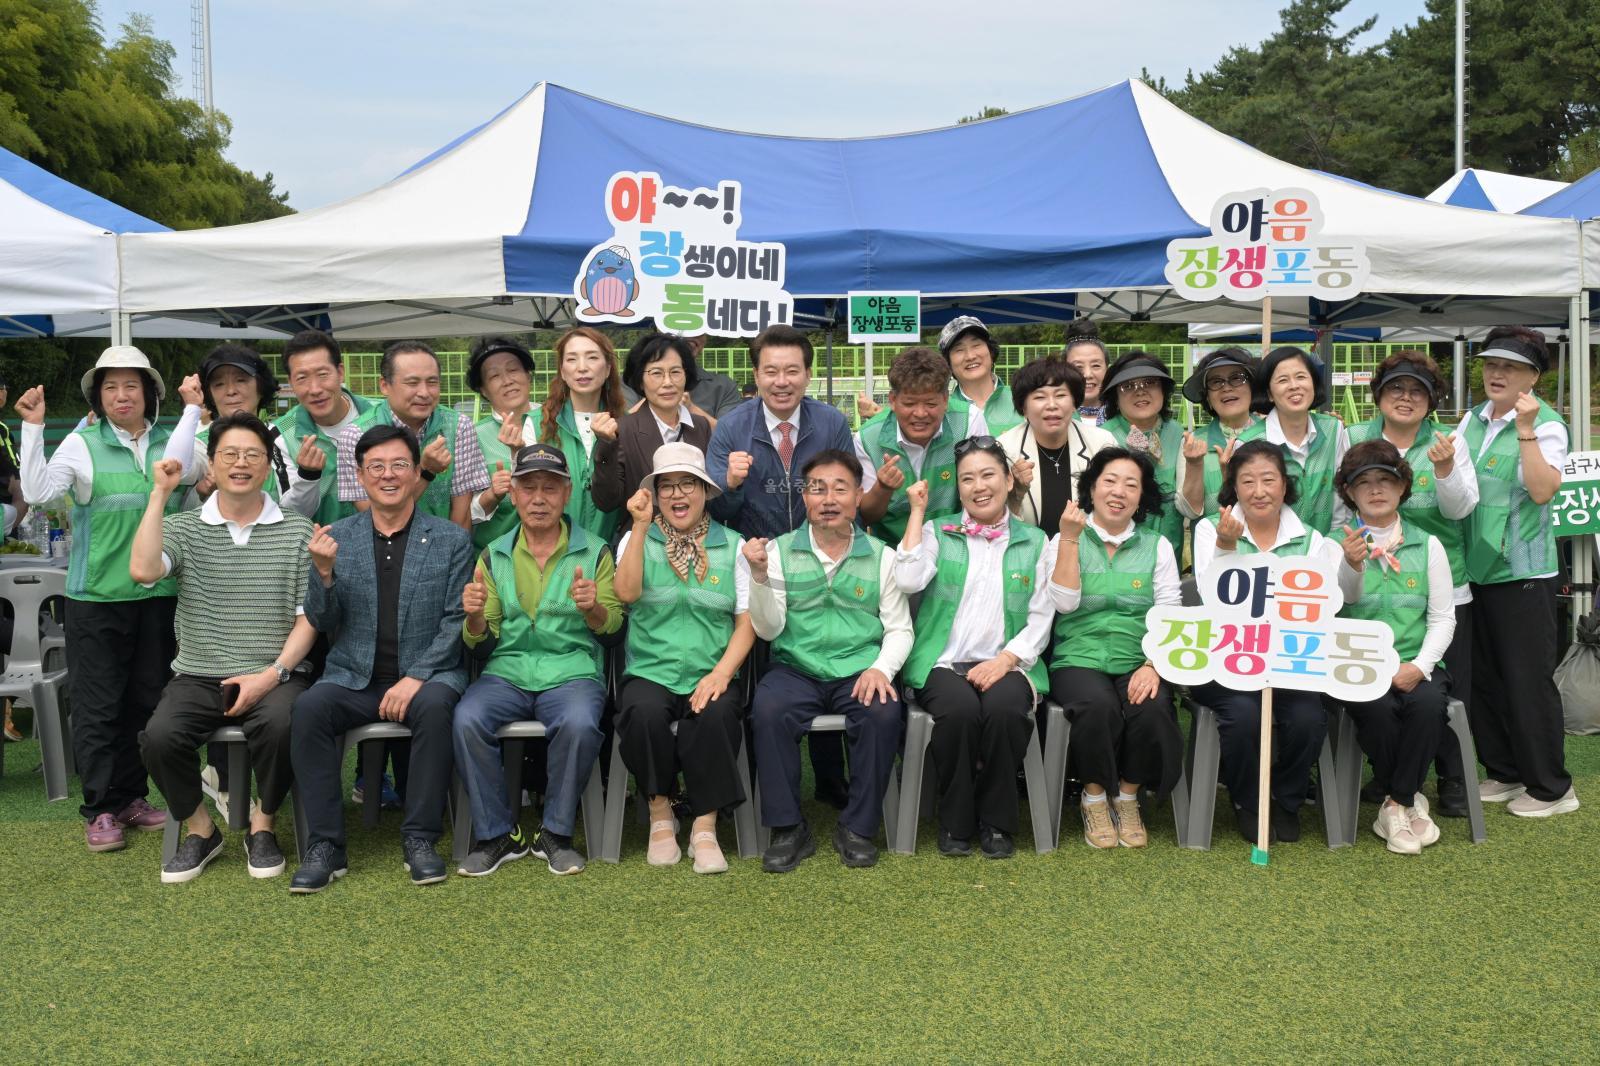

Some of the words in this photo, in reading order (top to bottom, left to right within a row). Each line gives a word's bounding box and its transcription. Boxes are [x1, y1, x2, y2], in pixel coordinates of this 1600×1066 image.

[1222, 198, 1312, 242] 야음
[639, 230, 780, 281] 장생이네
[1176, 245, 1358, 289] 장생포동
[851, 315, 917, 333] 장생포동
[868, 297, 901, 314] 야음
[1217, 566, 1329, 623] 야음
[1158, 619, 1385, 685] 장생포동
